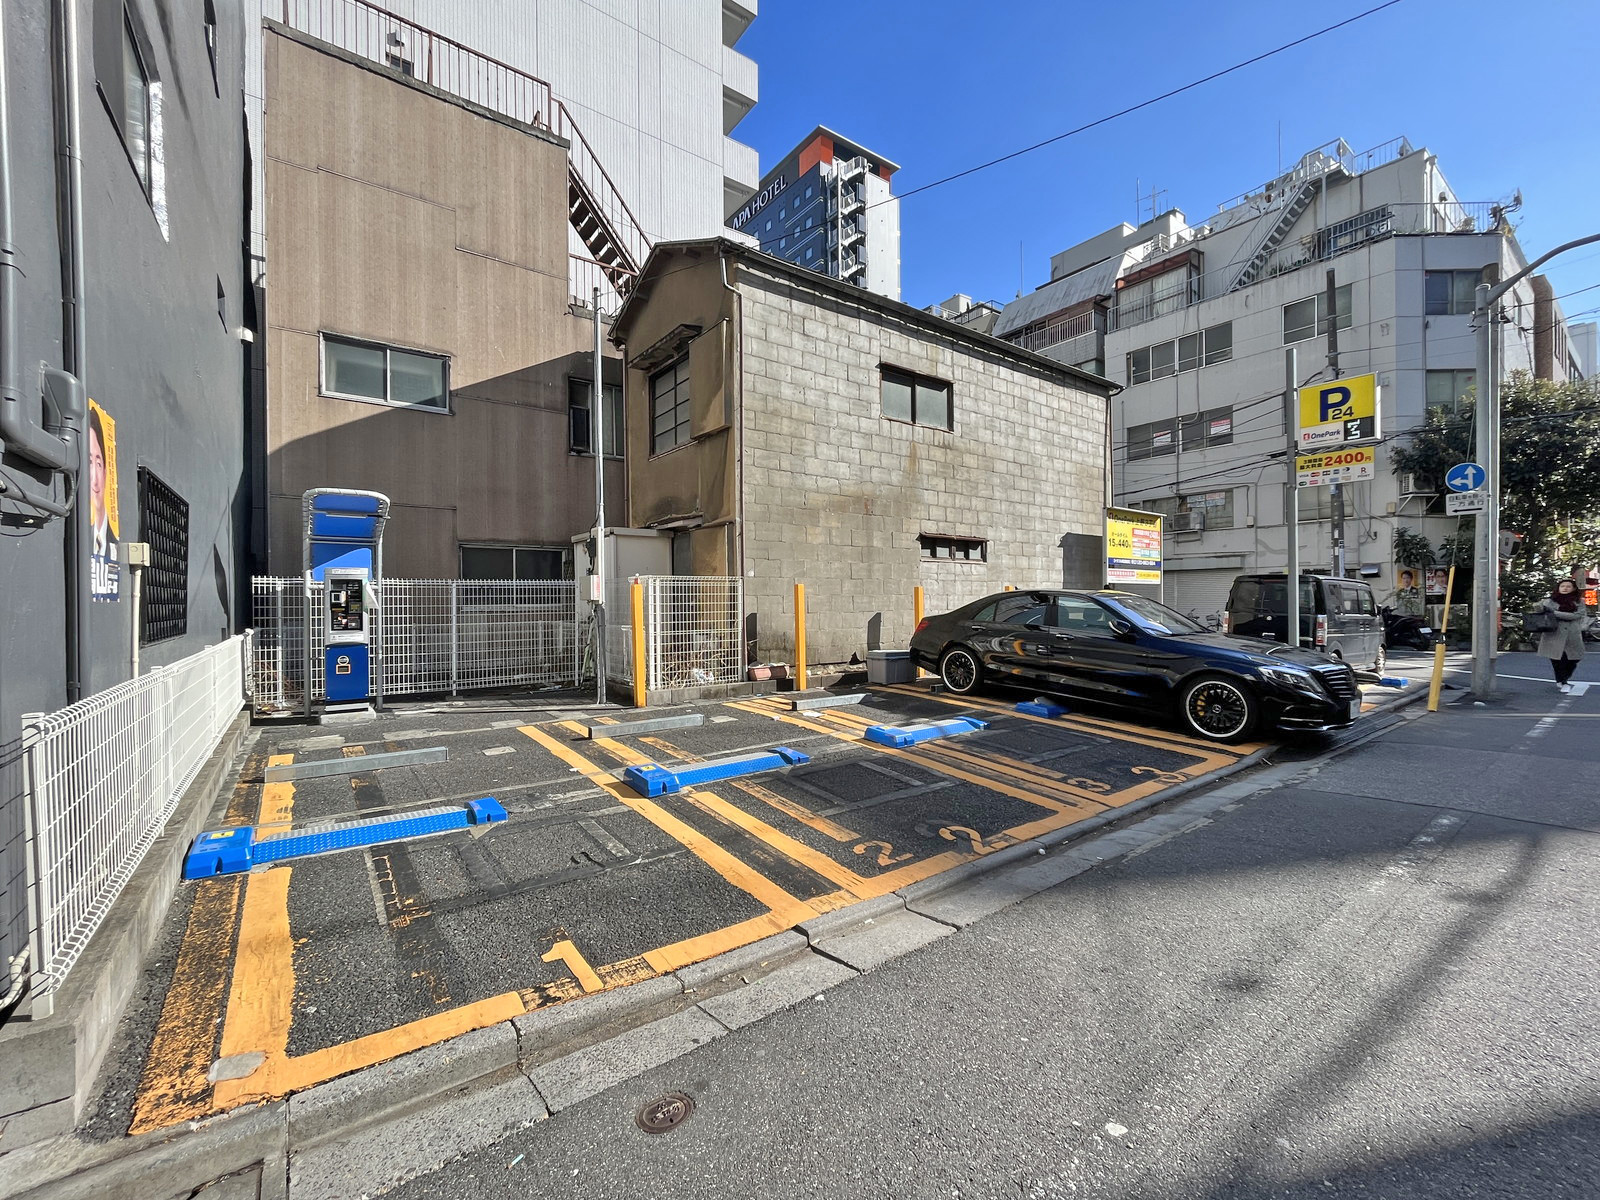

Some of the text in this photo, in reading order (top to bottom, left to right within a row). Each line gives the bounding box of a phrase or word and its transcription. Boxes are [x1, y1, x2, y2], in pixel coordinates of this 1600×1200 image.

[732, 176, 786, 229] APA HOTEL
[1320, 387, 1351, 422] P
[1332, 405, 1355, 420] 24
[1311, 429, 1341, 440] OnePark
[852, 839, 914, 867] 2
[938, 825, 1009, 855] 2
[541, 940, 604, 993] 1
